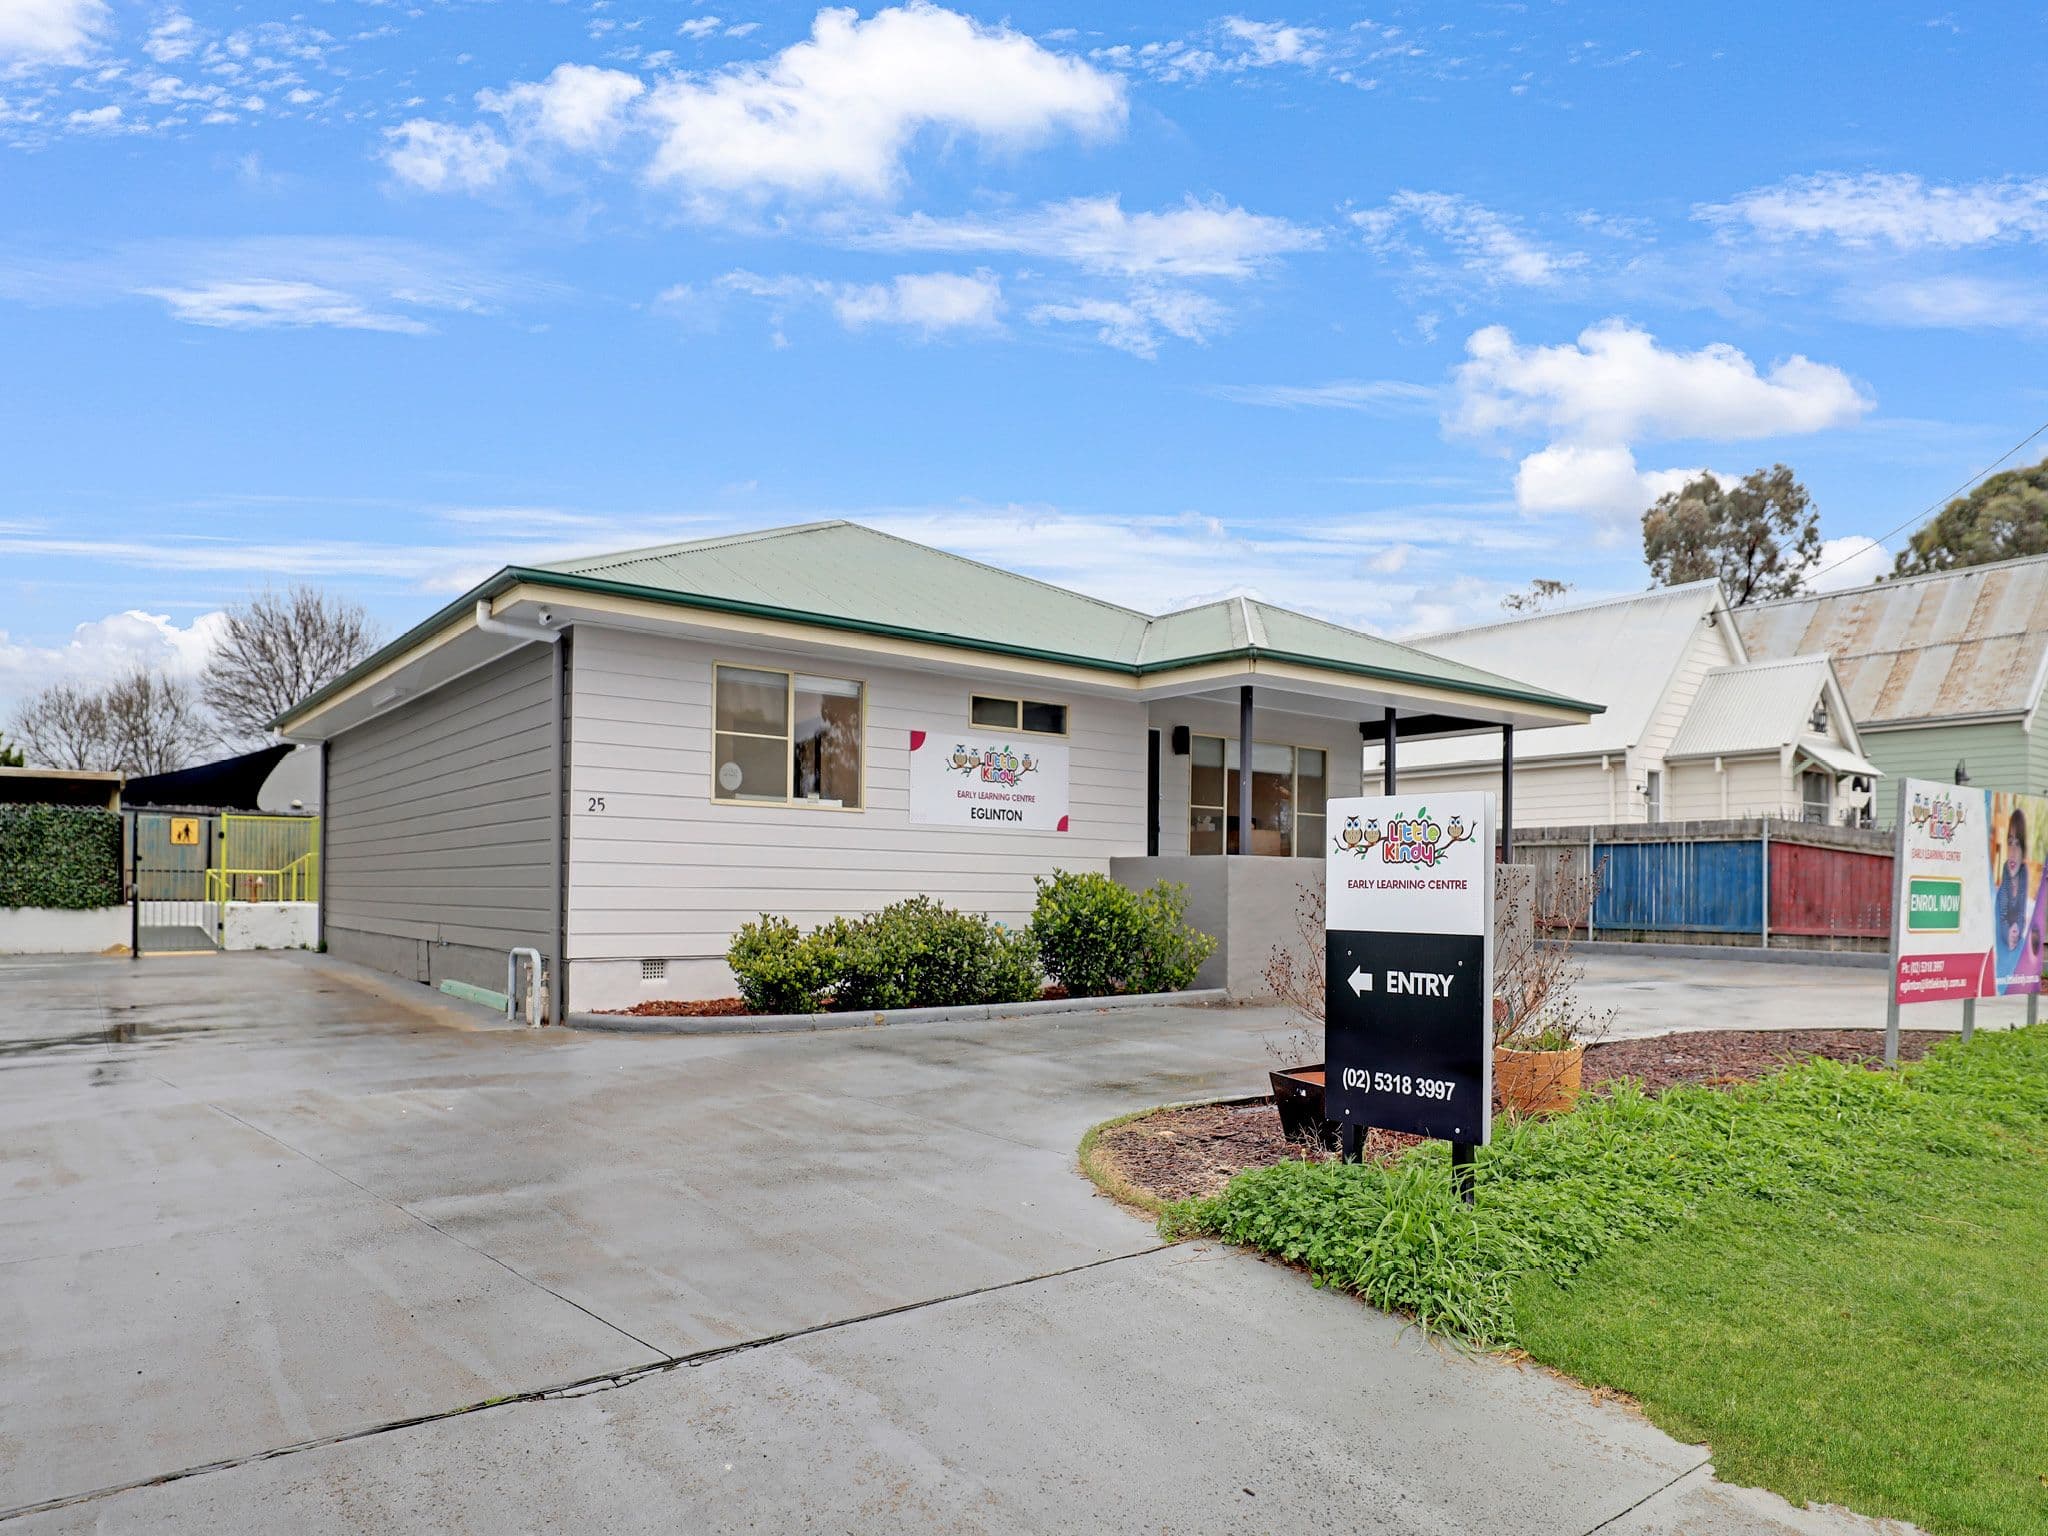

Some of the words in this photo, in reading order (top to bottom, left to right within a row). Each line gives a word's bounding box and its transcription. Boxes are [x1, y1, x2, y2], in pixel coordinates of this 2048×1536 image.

[985, 751, 1018, 772] Little
[981, 769, 1016, 787] Kindy
[588, 797, 606, 812] 25
[957, 790, 976, 800] EARLY
[978, 791, 1010, 802] LEARNING
[1011, 794, 1036, 803] CENTRE
[970, 807, 1023, 822] EGLINTON
[1389, 821, 1440, 843] Little
[1383, 842, 1434, 866] Kindy
[1348, 879, 1375, 889] EARLY
[1376, 880, 1425, 890] LEARNING
[1428, 880, 1468, 890] CENTRE
[1911, 893, 1938, 912] ENROL
[1940, 894, 1961, 912] NOW
[1386, 970, 1455, 998] ENTRY
[1342, 1067, 1371, 1094] (02)
[1374, 1072, 1412, 1095] 5318
[1415, 1077, 1456, 1101] 3997
